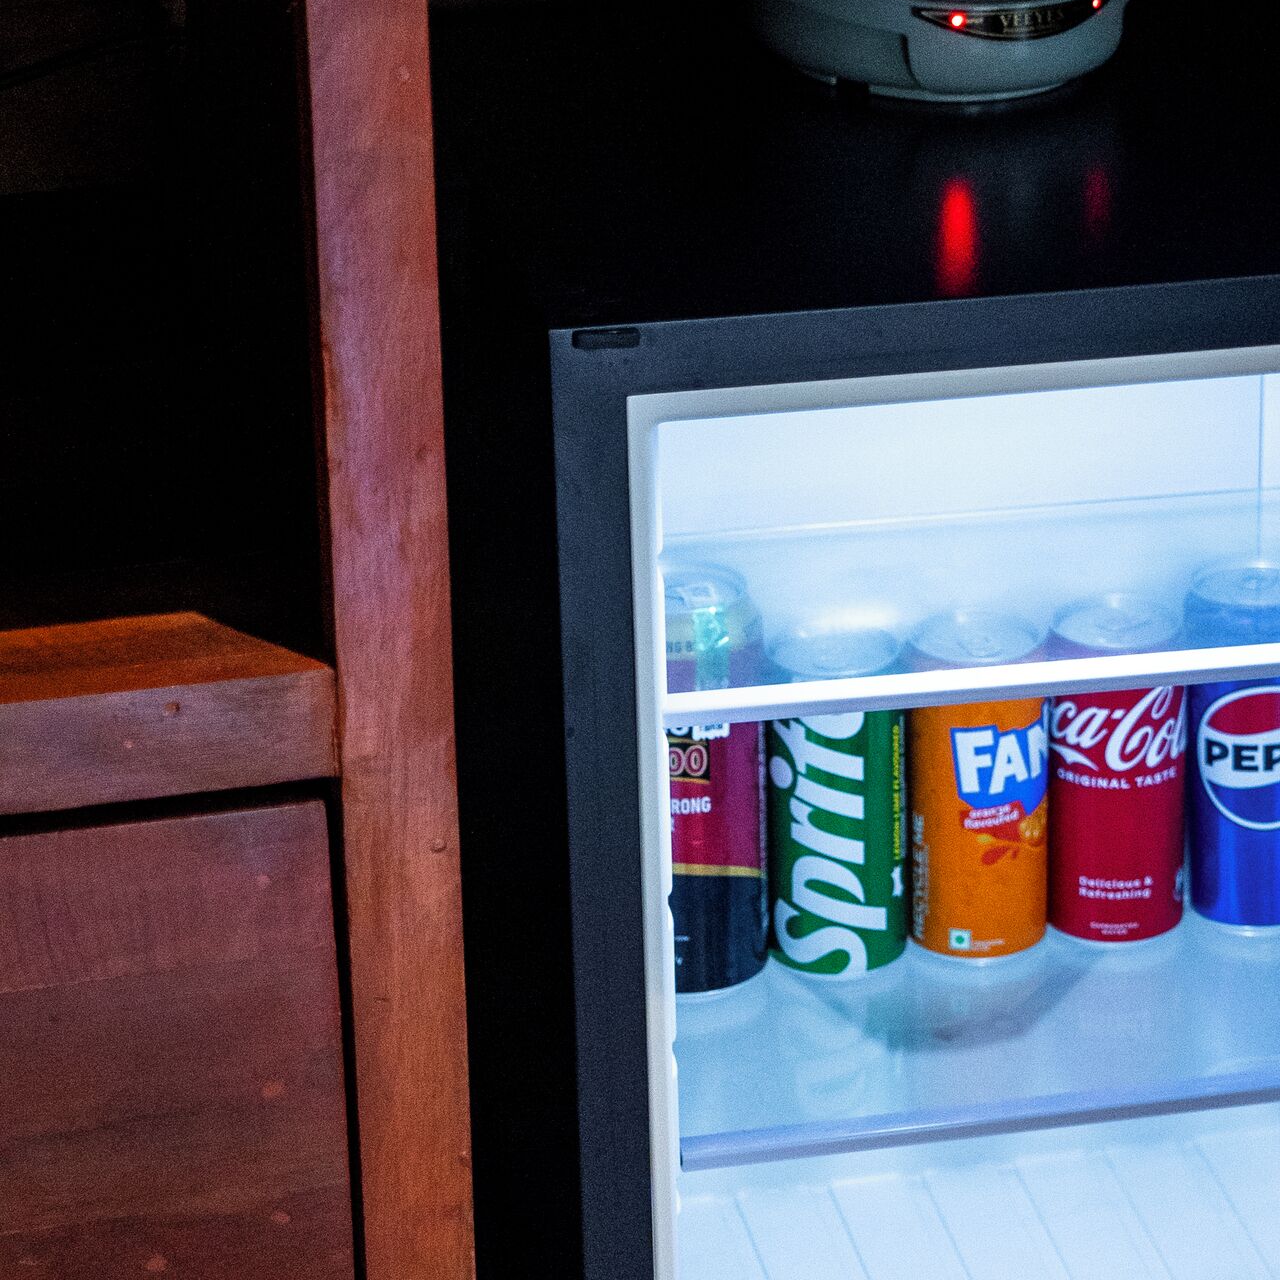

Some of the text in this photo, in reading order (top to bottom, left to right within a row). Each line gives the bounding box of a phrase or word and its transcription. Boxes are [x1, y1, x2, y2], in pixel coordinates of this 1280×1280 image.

[1057, 765, 1178, 790] ORIGINAL TASTE
[1079, 875, 1153, 890] Delicious &
[1079, 886, 1151, 900] Refreshing
